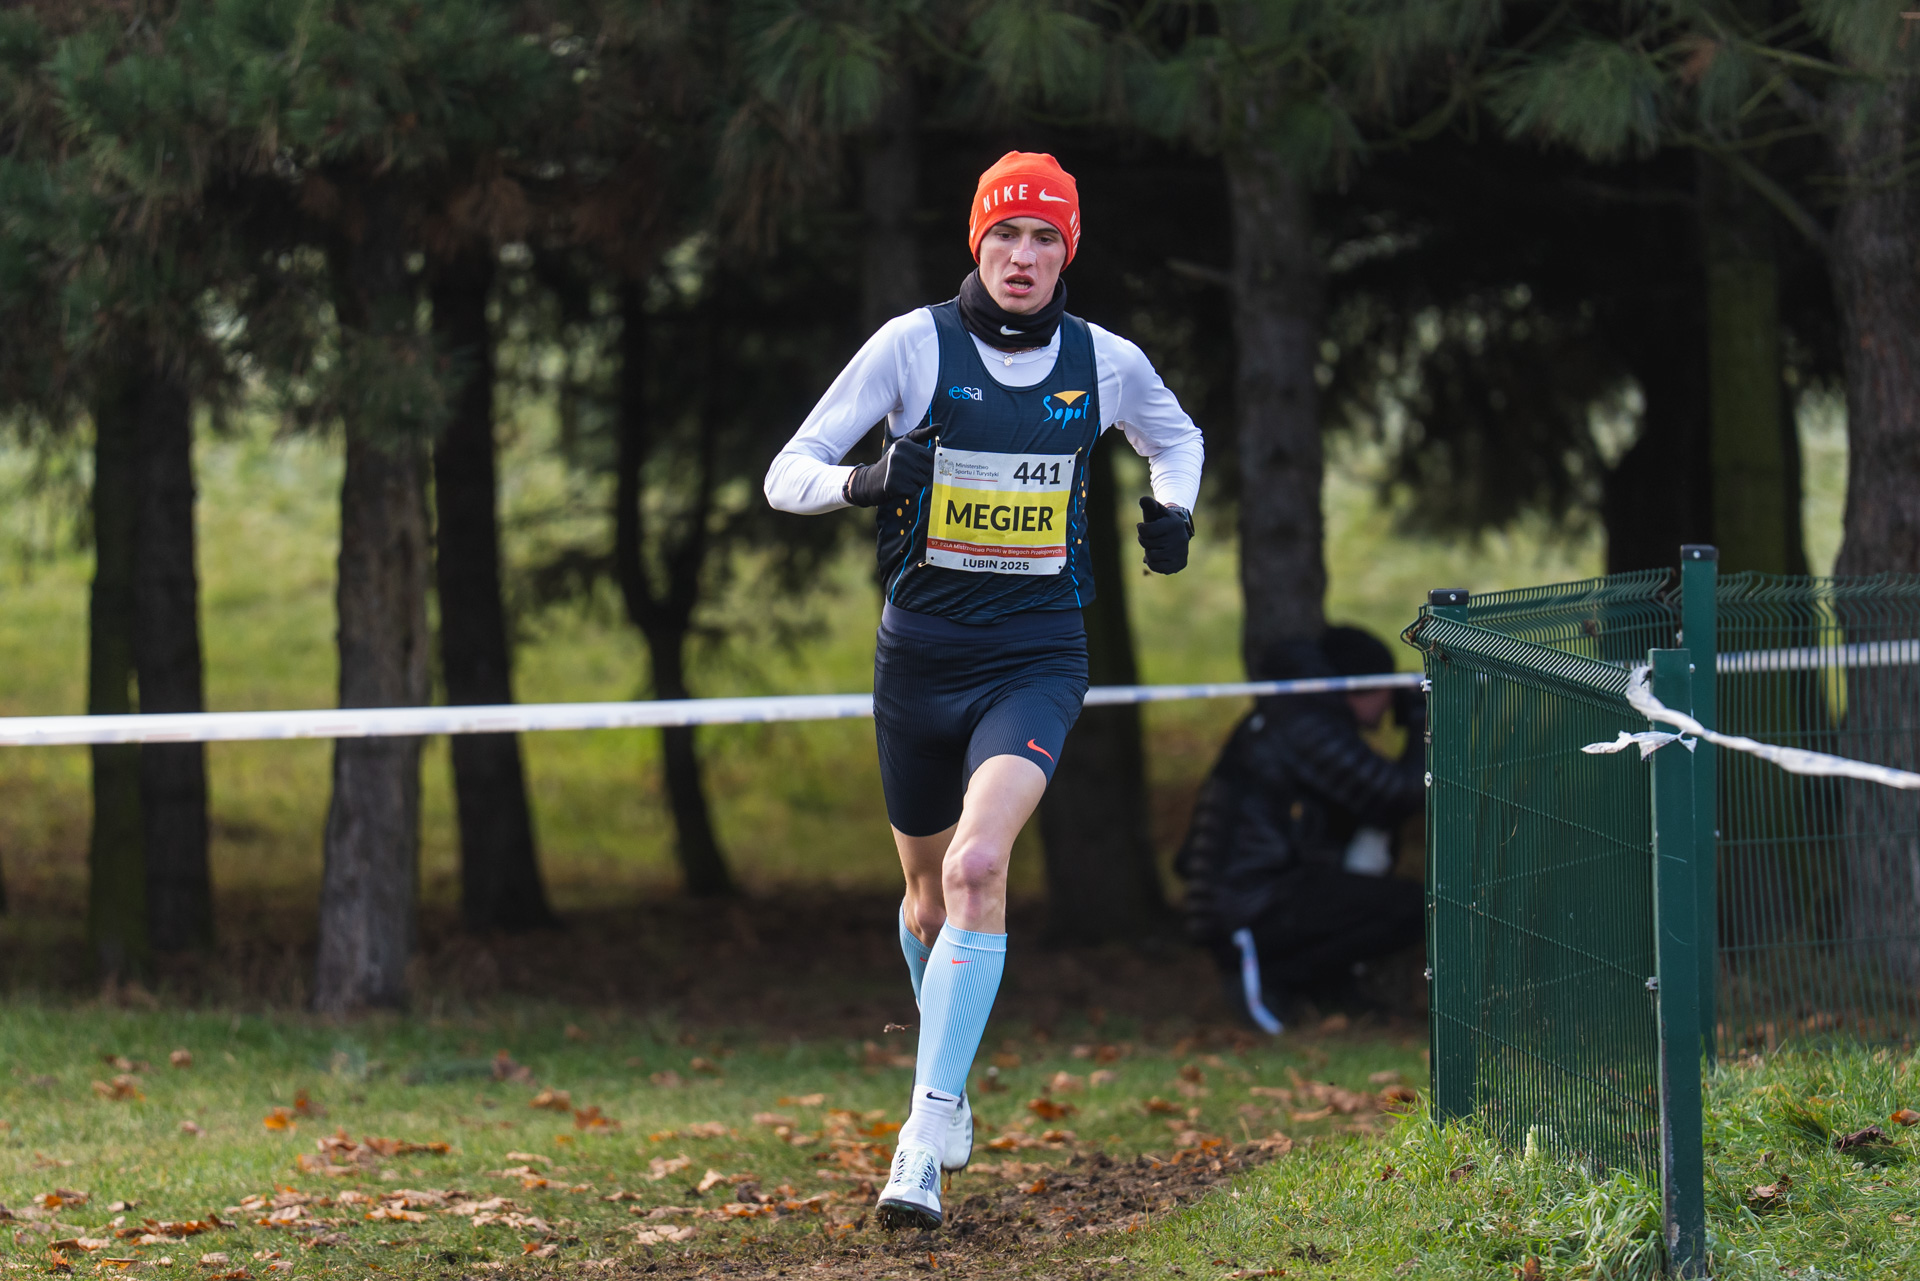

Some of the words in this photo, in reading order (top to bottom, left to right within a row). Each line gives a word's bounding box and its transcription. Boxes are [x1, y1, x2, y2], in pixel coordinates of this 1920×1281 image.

[983, 184, 1029, 214] NIKE
[1043, 393, 1090, 430] Sopot
[1013, 462, 1061, 485] 441
[945, 499, 1053, 532] MEGIER
[953, 544, 985, 553] Mistrzostwa
[1008, 548, 1030, 556] Biegach
[963, 558, 998, 569] LUBIN
[1000, 561, 1030, 571] 2025
